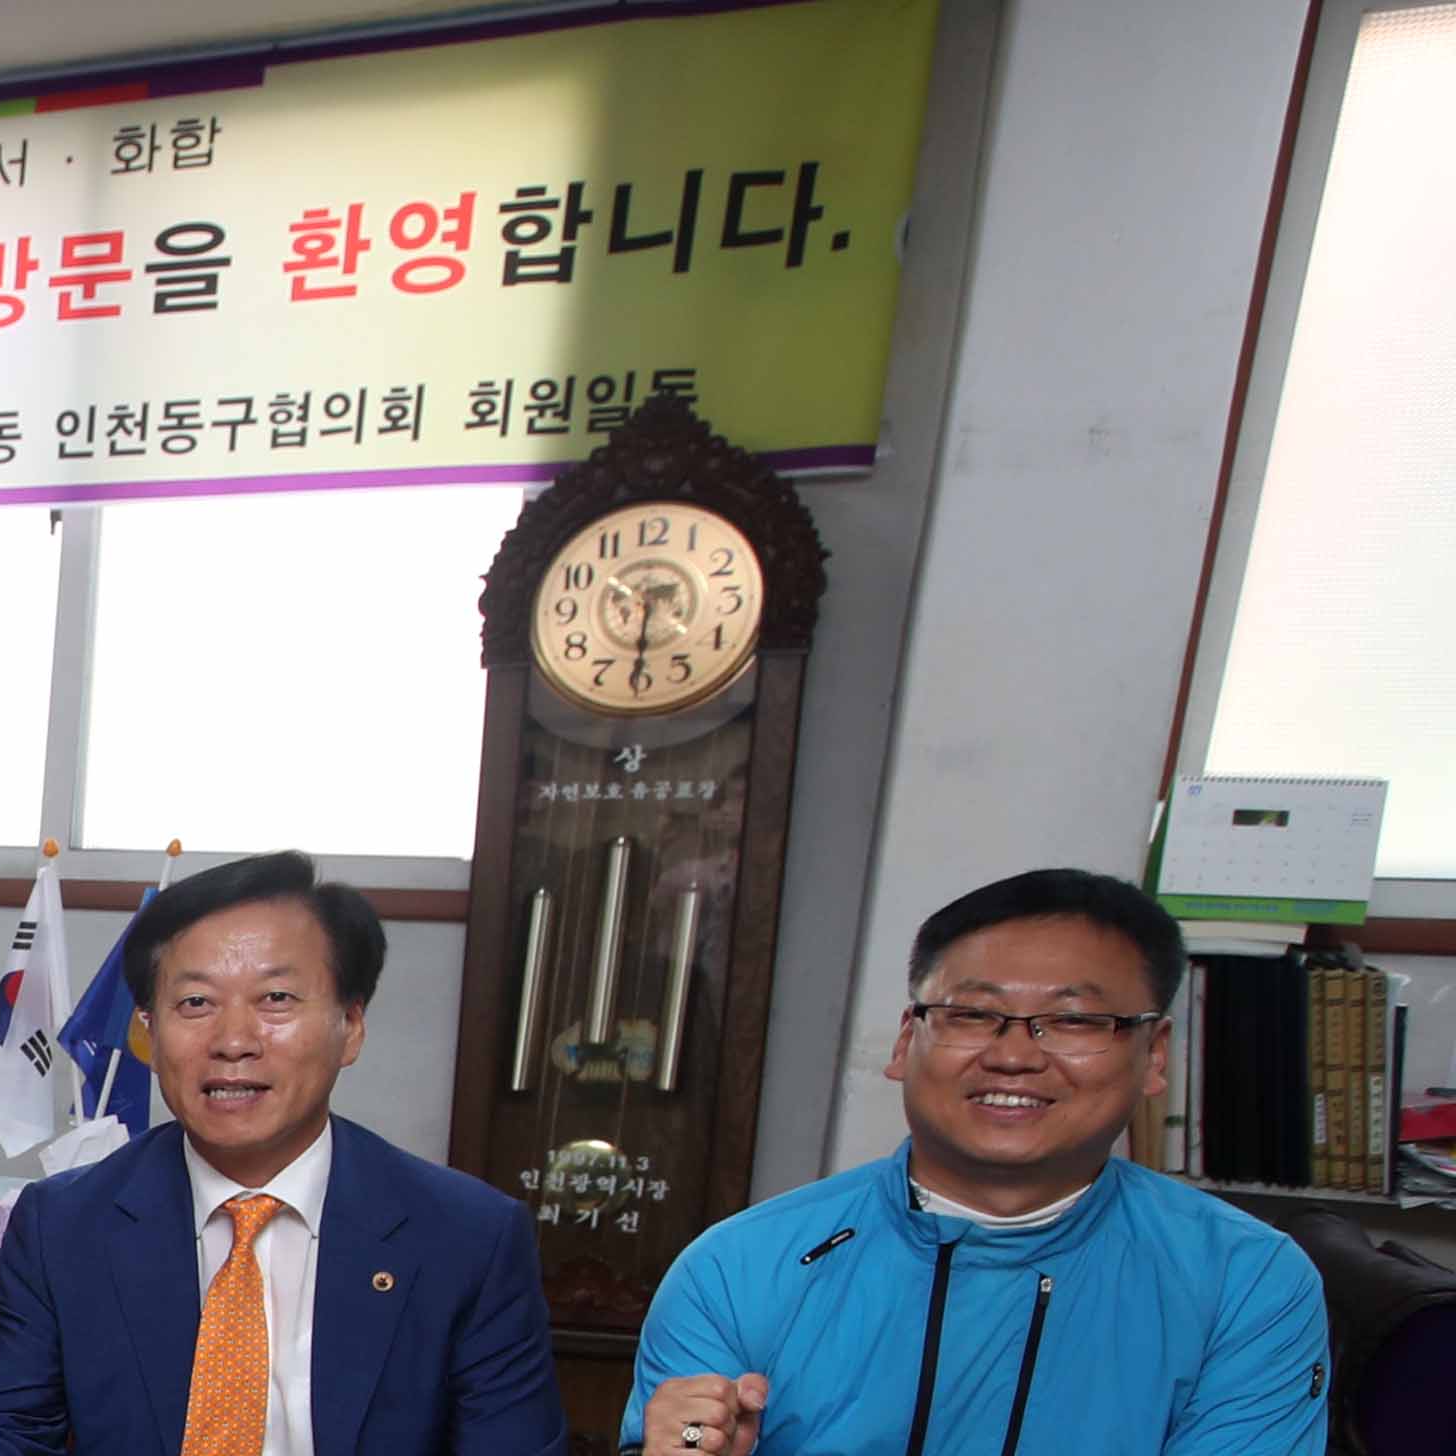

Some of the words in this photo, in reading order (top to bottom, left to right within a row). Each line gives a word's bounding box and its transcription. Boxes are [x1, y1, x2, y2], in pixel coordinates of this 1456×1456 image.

[110, 115, 222, 176] 화합
[283, 161, 851, 302] 환영합니다.
[55, 383, 425, 461] 인천동구협의회
[598, 528, 620, 559] 11
[638, 516, 670, 547] 12
[687, 523, 697, 551] 1
[562, 562, 593, 590] 10
[710, 548, 734, 577] 2
[555, 596, 577, 625] 9
[717, 586, 742, 615] 3
[564, 631, 588, 660] 8
[592, 659, 616, 687] 7
[666, 654, 692, 684] 5
[614, 744, 647, 773] 상
[520, 1168, 671, 1200] 인천광역시장
